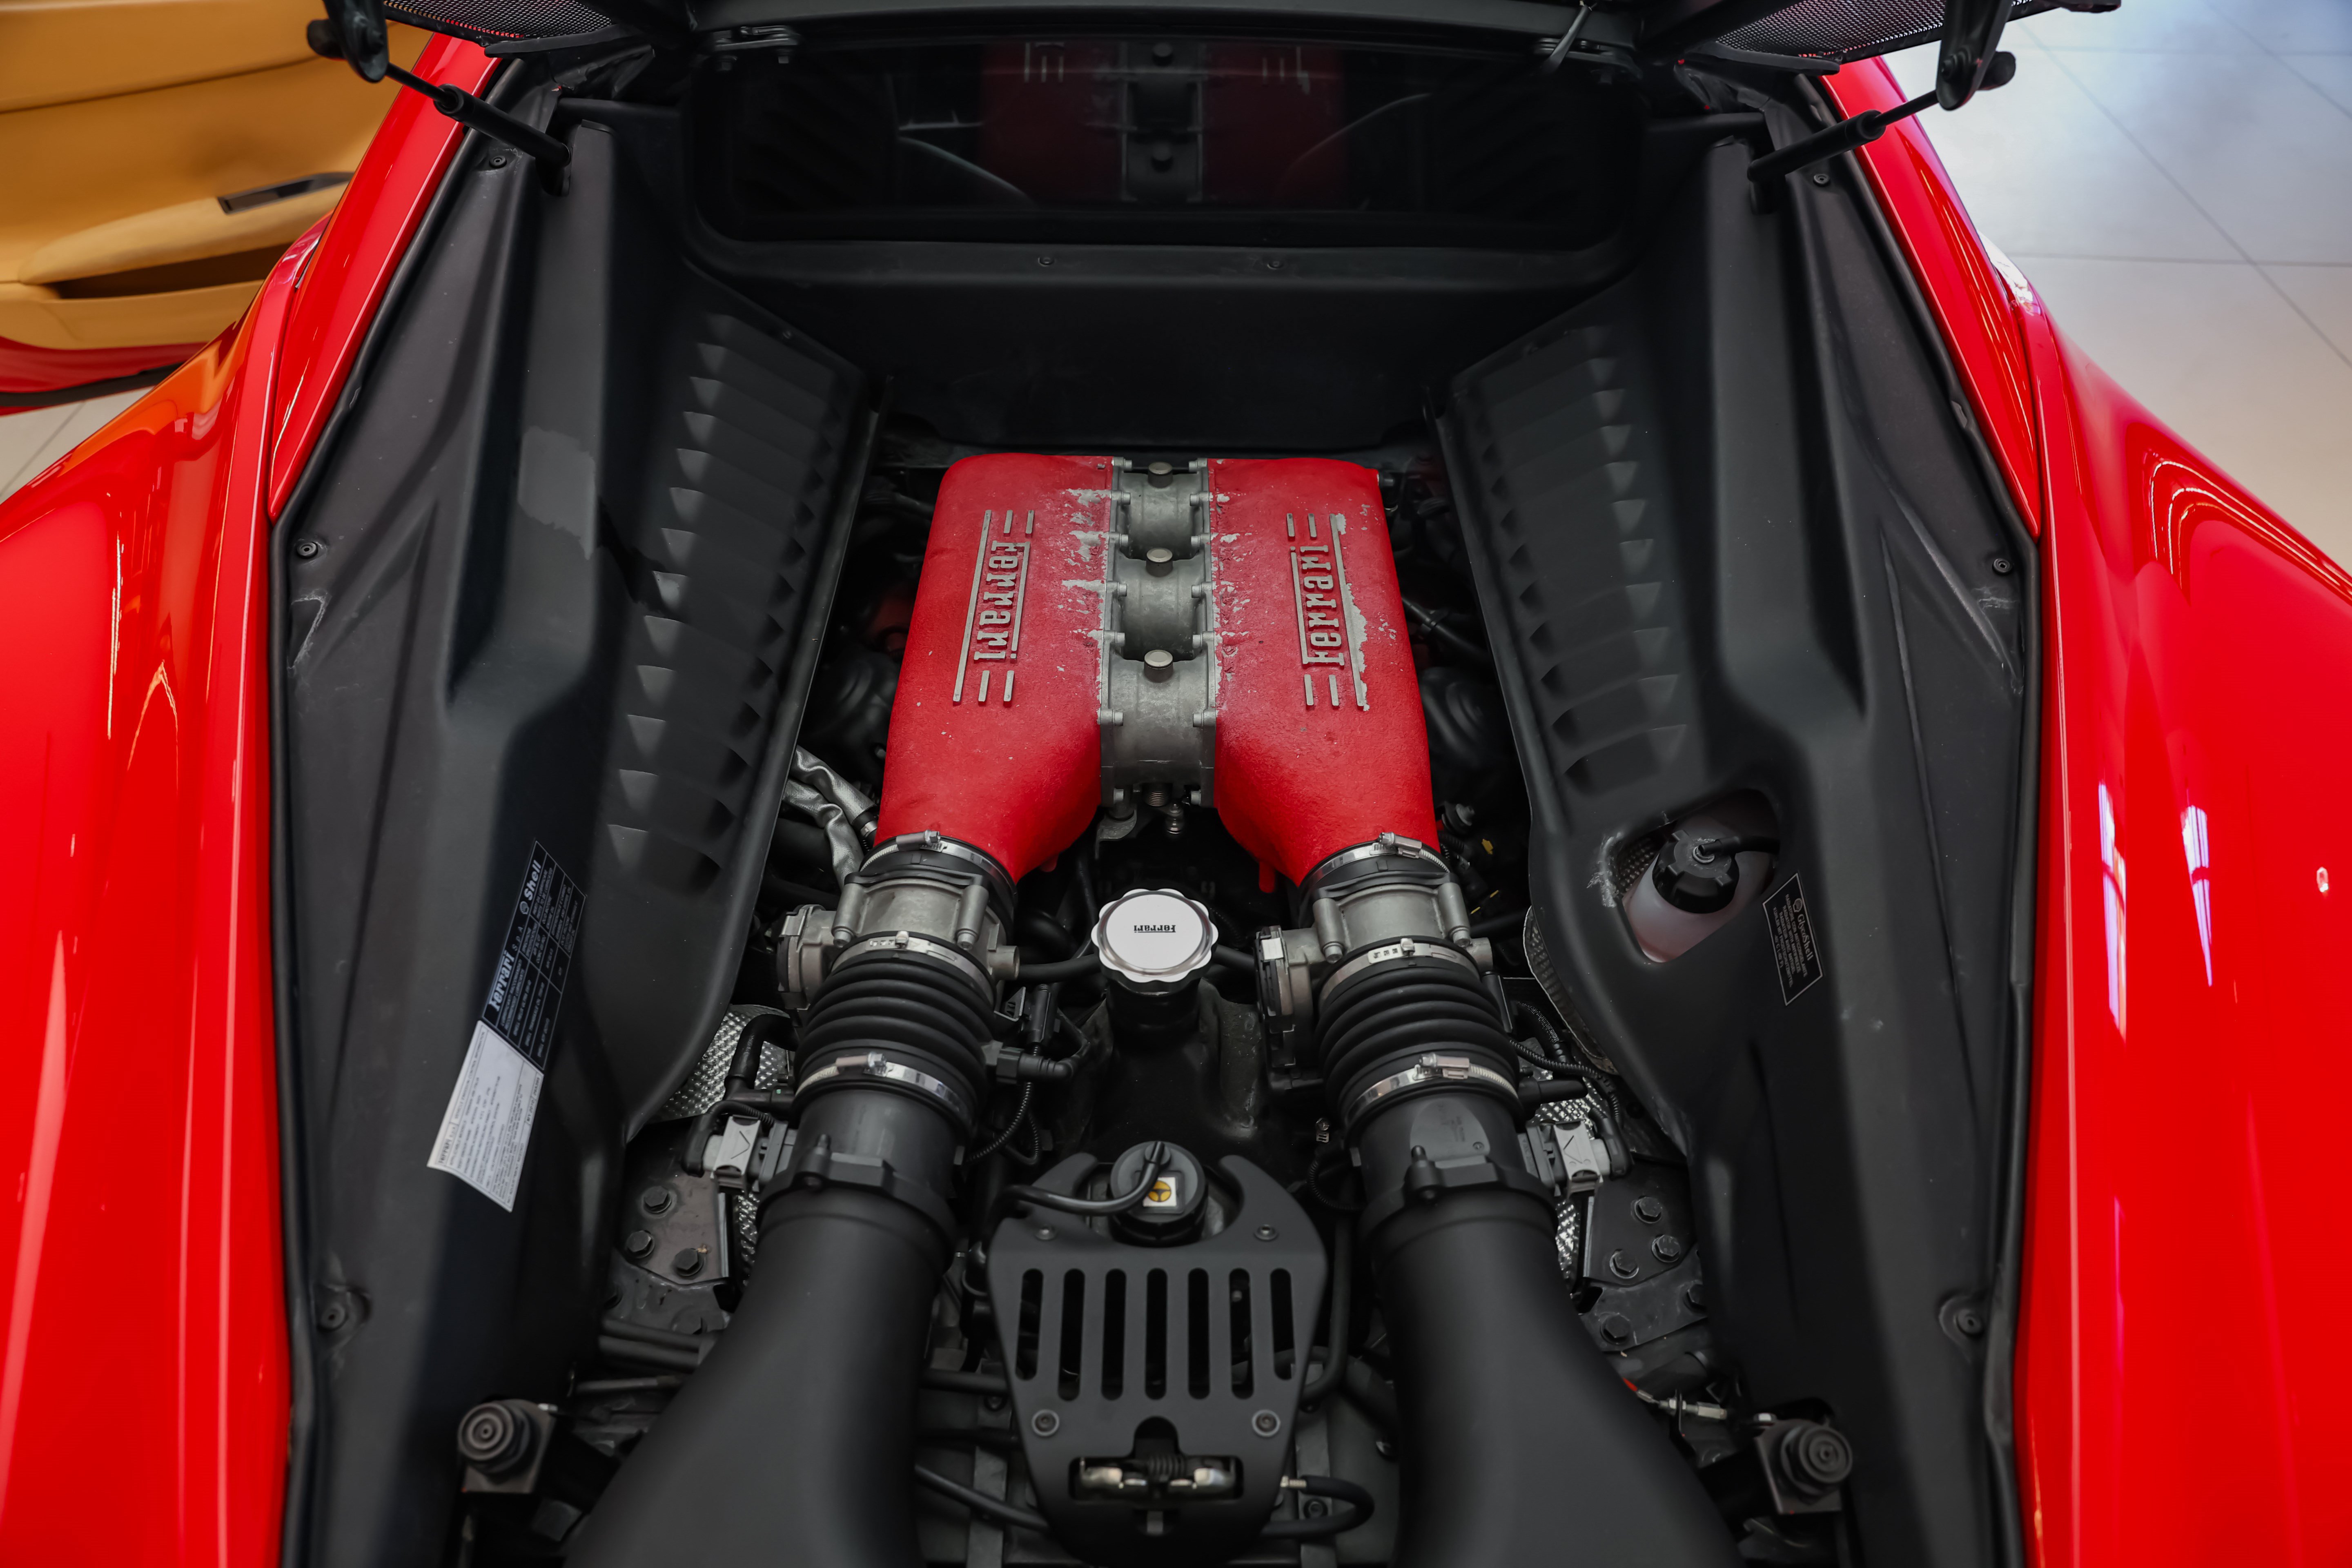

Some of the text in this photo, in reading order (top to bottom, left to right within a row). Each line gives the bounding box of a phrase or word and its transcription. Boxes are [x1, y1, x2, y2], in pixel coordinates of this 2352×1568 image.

[974, 541, 1031, 661] Ferrari
[1290, 544, 1345, 666] Ferrari
[524, 860, 541, 900] Shell
[1134, 924, 1176, 933] Ferrari
[1797, 914, 1813, 960] GlycoShell
[488, 951, 514, 1010] Ferrari
